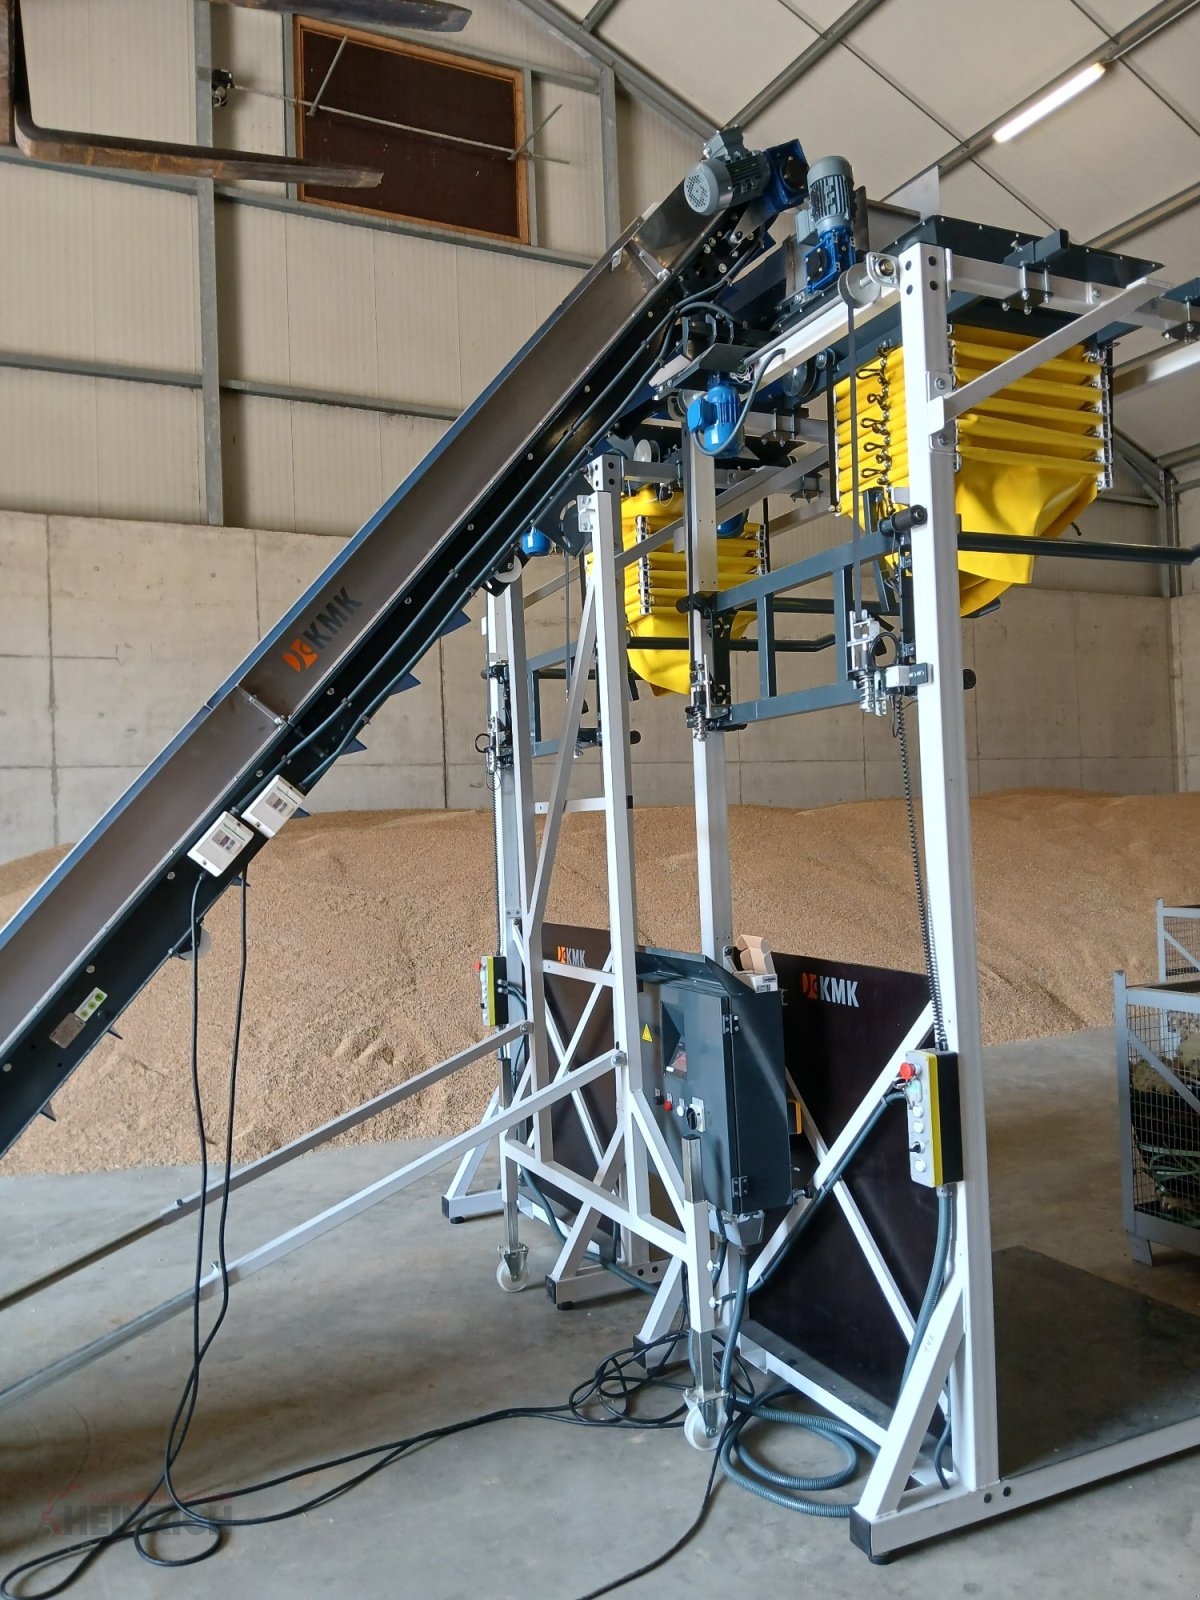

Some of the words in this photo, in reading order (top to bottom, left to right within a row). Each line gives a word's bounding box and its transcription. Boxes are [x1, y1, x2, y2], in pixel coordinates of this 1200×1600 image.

[303, 586, 362, 649] KMK
[566, 947, 586, 968] KMK
[819, 976, 860, 1008] KMK
